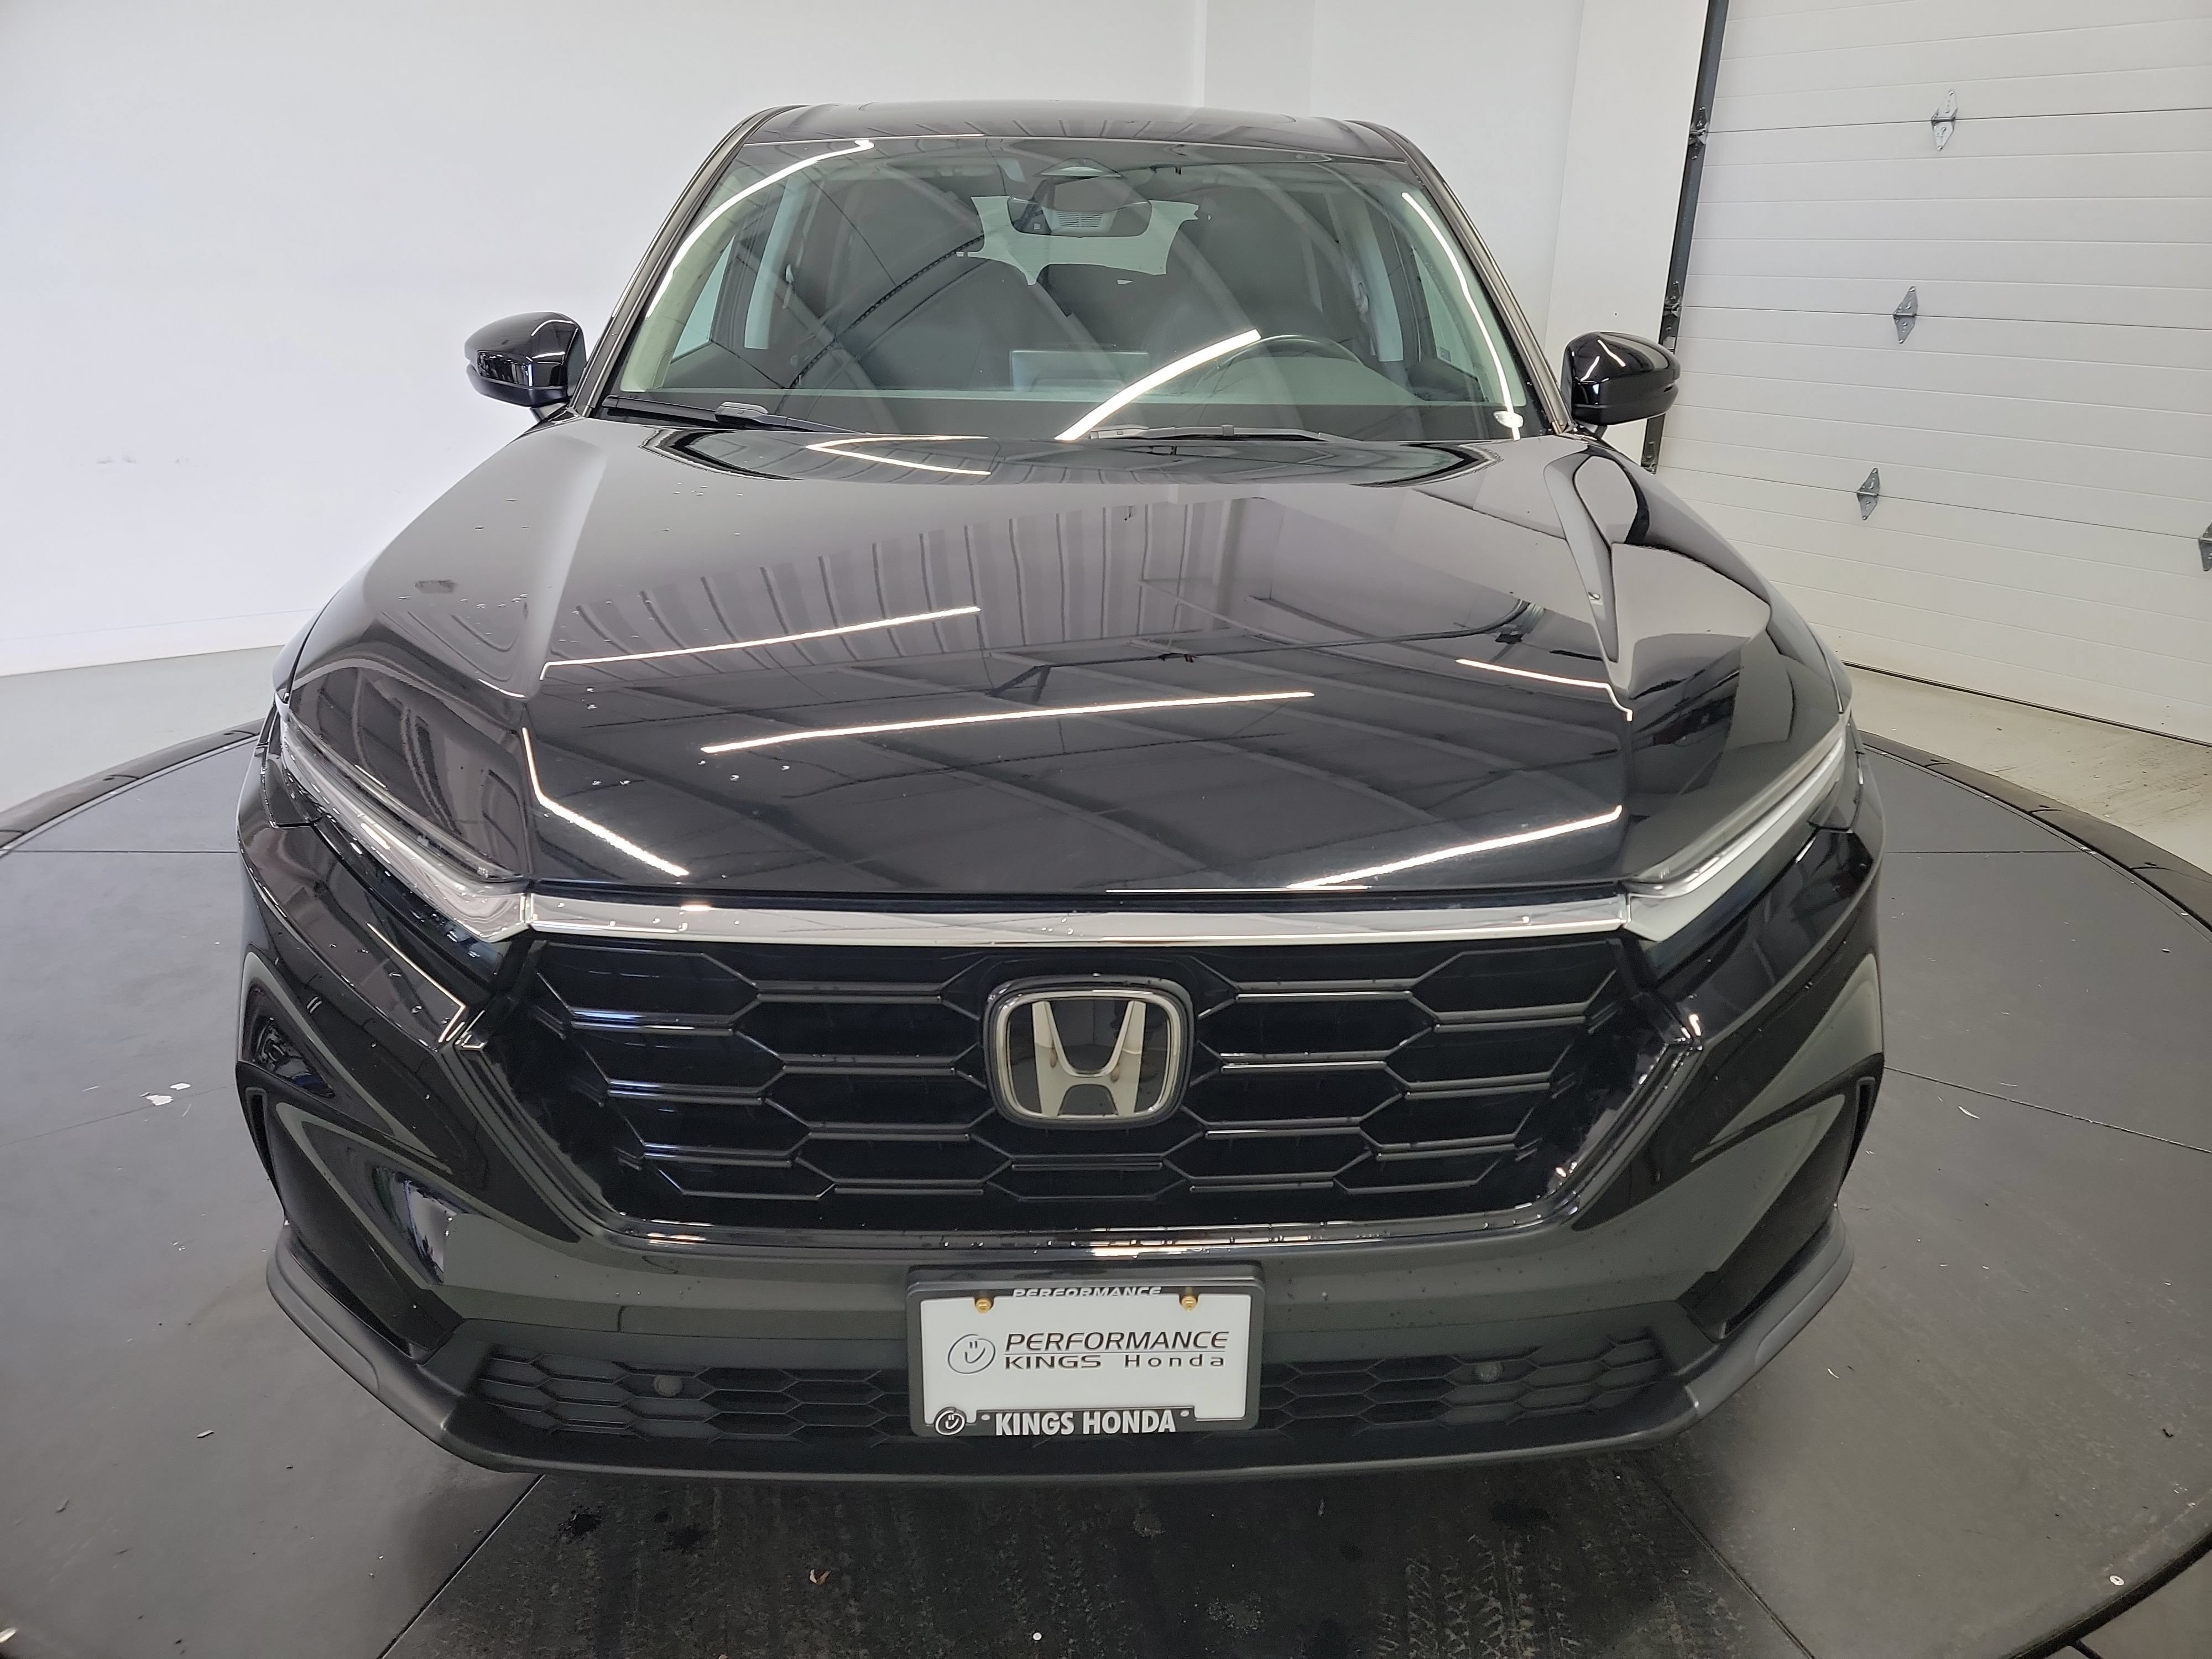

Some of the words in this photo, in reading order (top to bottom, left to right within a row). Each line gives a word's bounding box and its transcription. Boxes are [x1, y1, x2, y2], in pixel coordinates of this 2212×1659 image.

[1013, 1286, 1161, 1297] PERFORMANCE
[1005, 1331, 1229, 1352] PERFORMANCE
[1005, 1355, 1102, 1370] KINGS
[1124, 1354, 1224, 1368] Honda
[995, 1412, 1074, 1436] KINGS
[1083, 1409, 1176, 1434] HONDA
